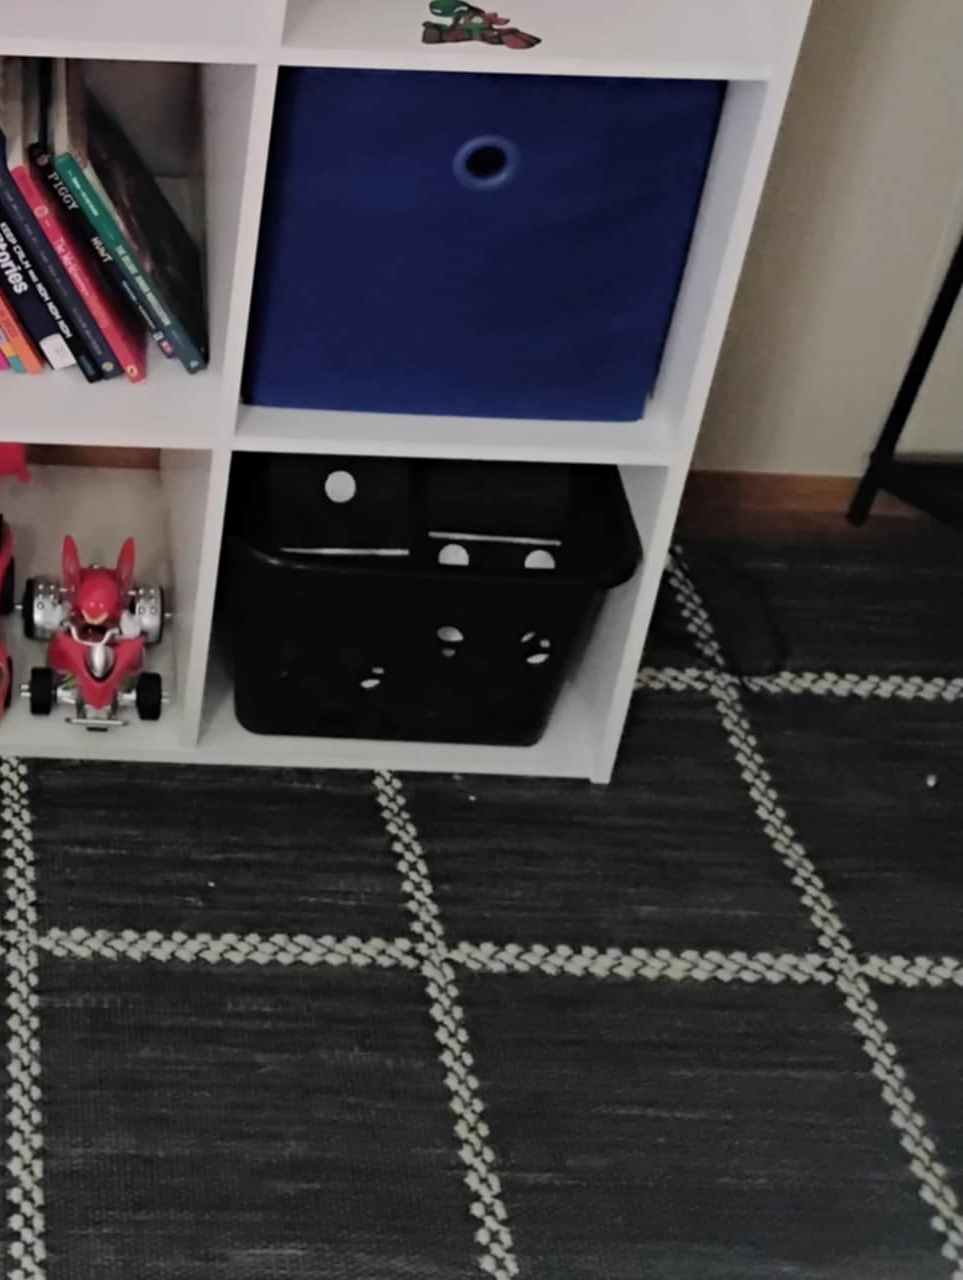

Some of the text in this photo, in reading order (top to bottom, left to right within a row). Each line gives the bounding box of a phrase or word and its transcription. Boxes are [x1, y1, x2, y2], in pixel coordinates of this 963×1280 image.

[45, 169, 79, 214] PIGGY
[88, 233, 113, 265] HUNT
[10, 244, 31, 271] CALM
[33, 281, 50, 303] NOM
[44, 300, 62, 322] NOM
[55, 318, 74, 341] NOM
